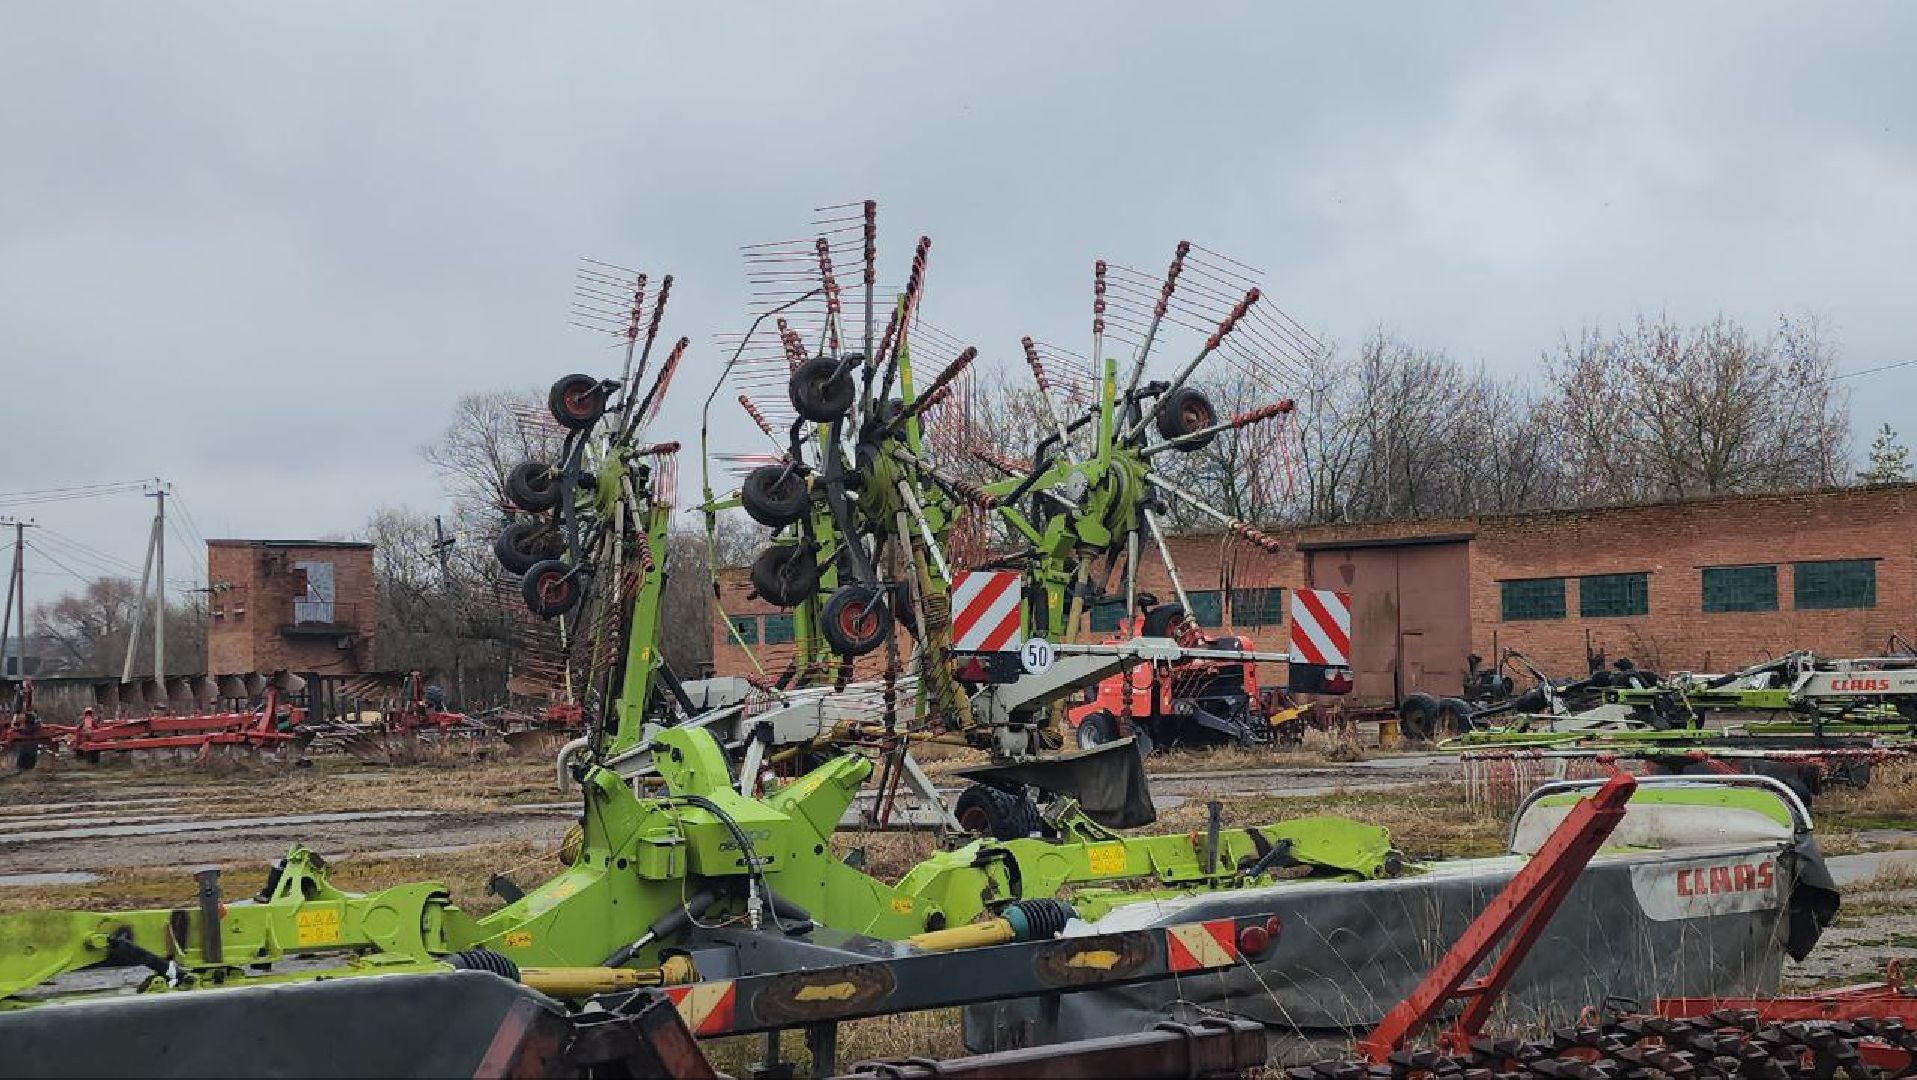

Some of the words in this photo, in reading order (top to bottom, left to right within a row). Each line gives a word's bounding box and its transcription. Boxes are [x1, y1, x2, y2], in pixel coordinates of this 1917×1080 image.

[1029, 644, 1047, 667] 50
[1831, 678, 1889, 691] CLAAS
[1677, 861, 1774, 896] CLAAS
